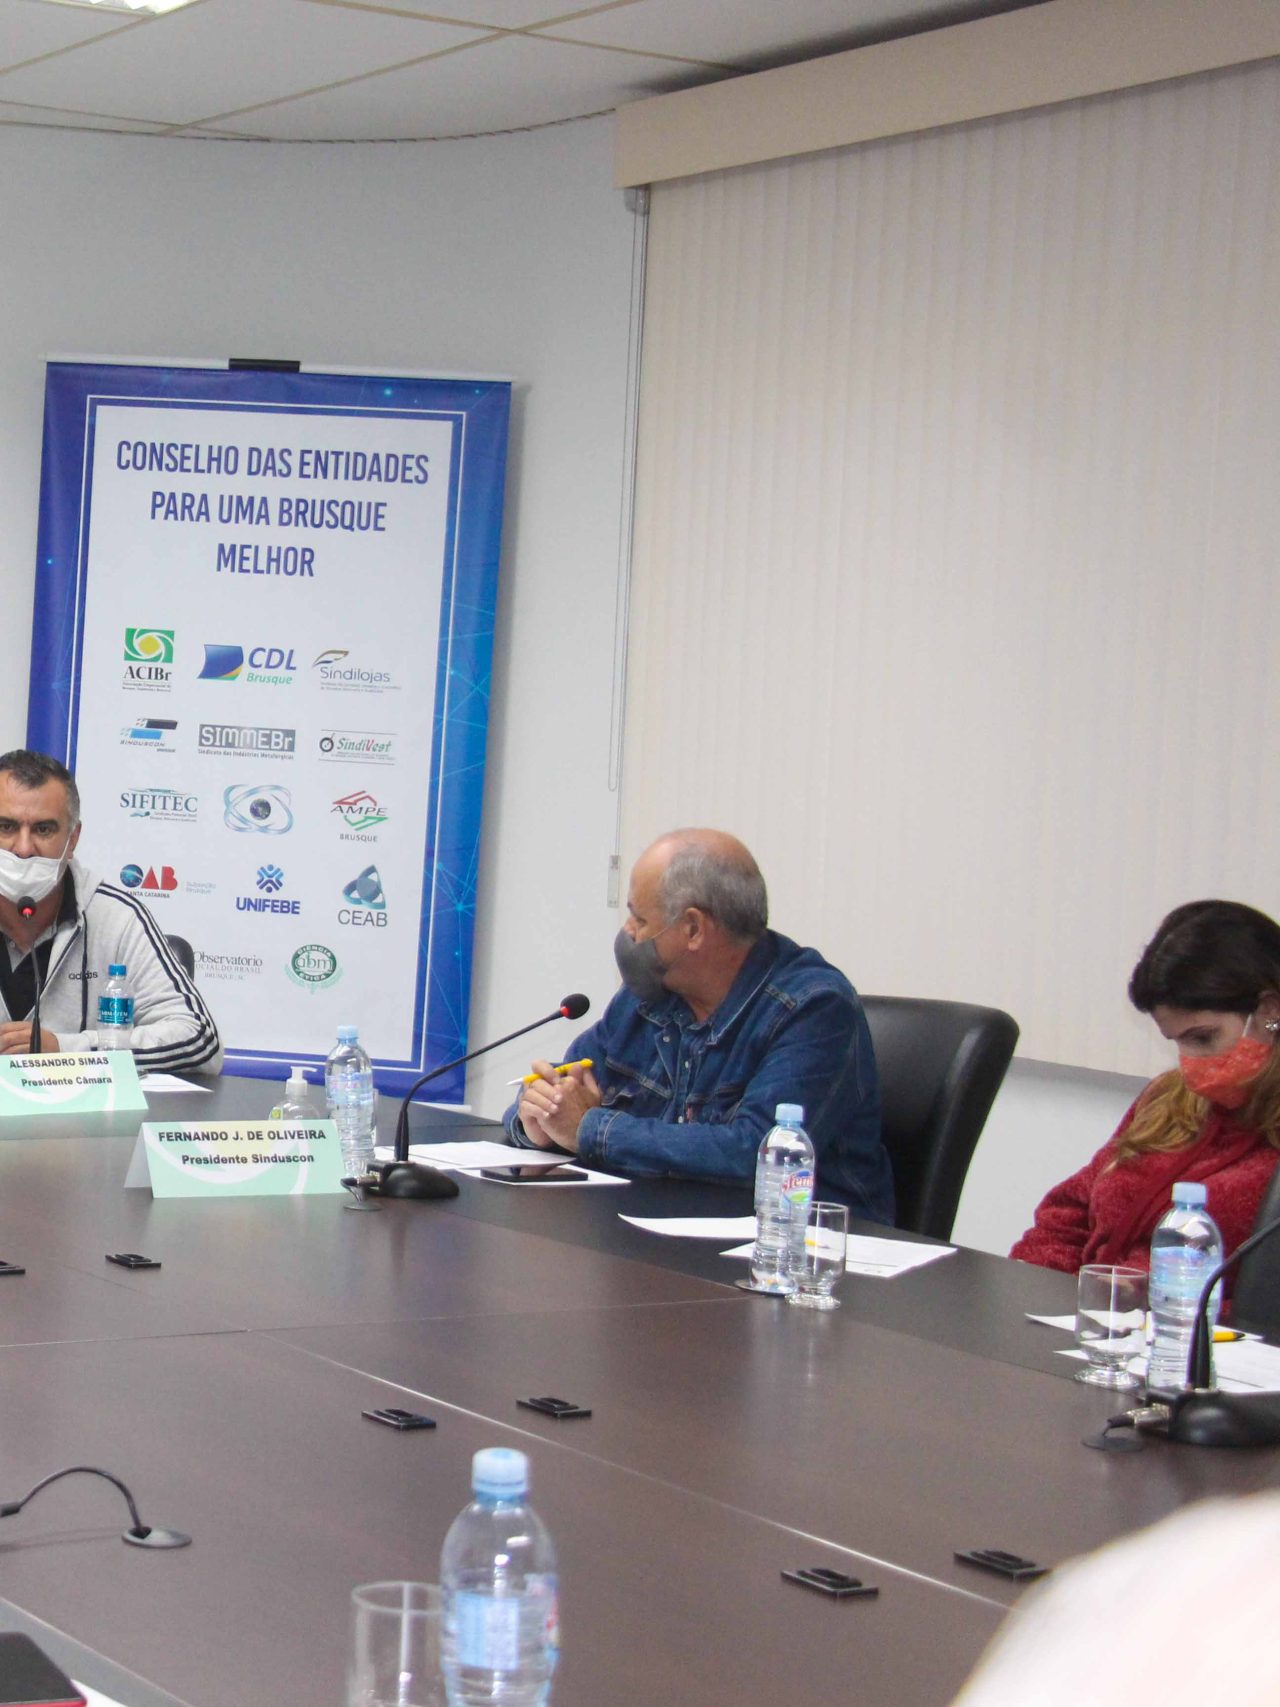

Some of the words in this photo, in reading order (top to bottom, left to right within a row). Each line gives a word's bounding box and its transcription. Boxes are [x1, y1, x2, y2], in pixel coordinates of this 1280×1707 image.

[116, 440, 239, 475] CONSELHO
[246, 446, 292, 478] DAS
[298, 449, 429, 485] ENTIDADES
[150, 491, 210, 522] PARA
[217, 494, 270, 526] UMA
[278, 497, 387, 532] BRUSQUE
[216, 543, 315, 577] MELHOR
[248, 647, 297, 670] CDL
[122, 665, 172, 681] ACIBr
[246, 672, 293, 686] Brusque
[320, 666, 391, 684] Sindilojas
[119, 792, 198, 813] SIFITEC
[330, 805, 388, 816] AMPE
[340, 833, 378, 842] BRUSQUE
[235, 896, 301, 915] UNIFEBE
[337, 909, 388, 928] CEAB
[9, 1058, 76, 1069] ALESSANDRO
[78, 1056, 110, 1066] SIMAS
[21, 1077, 74, 1087] Presidente
[158, 1131, 229, 1142] FERNANDO
[232, 1130, 244, 1141] J.
[247, 1130, 264, 1141] DE
[266, 1129, 327, 1140] OLIVEIRA
[181, 1154, 249, 1165] Presidente
[251, 1153, 315, 1164] Sinduscon
